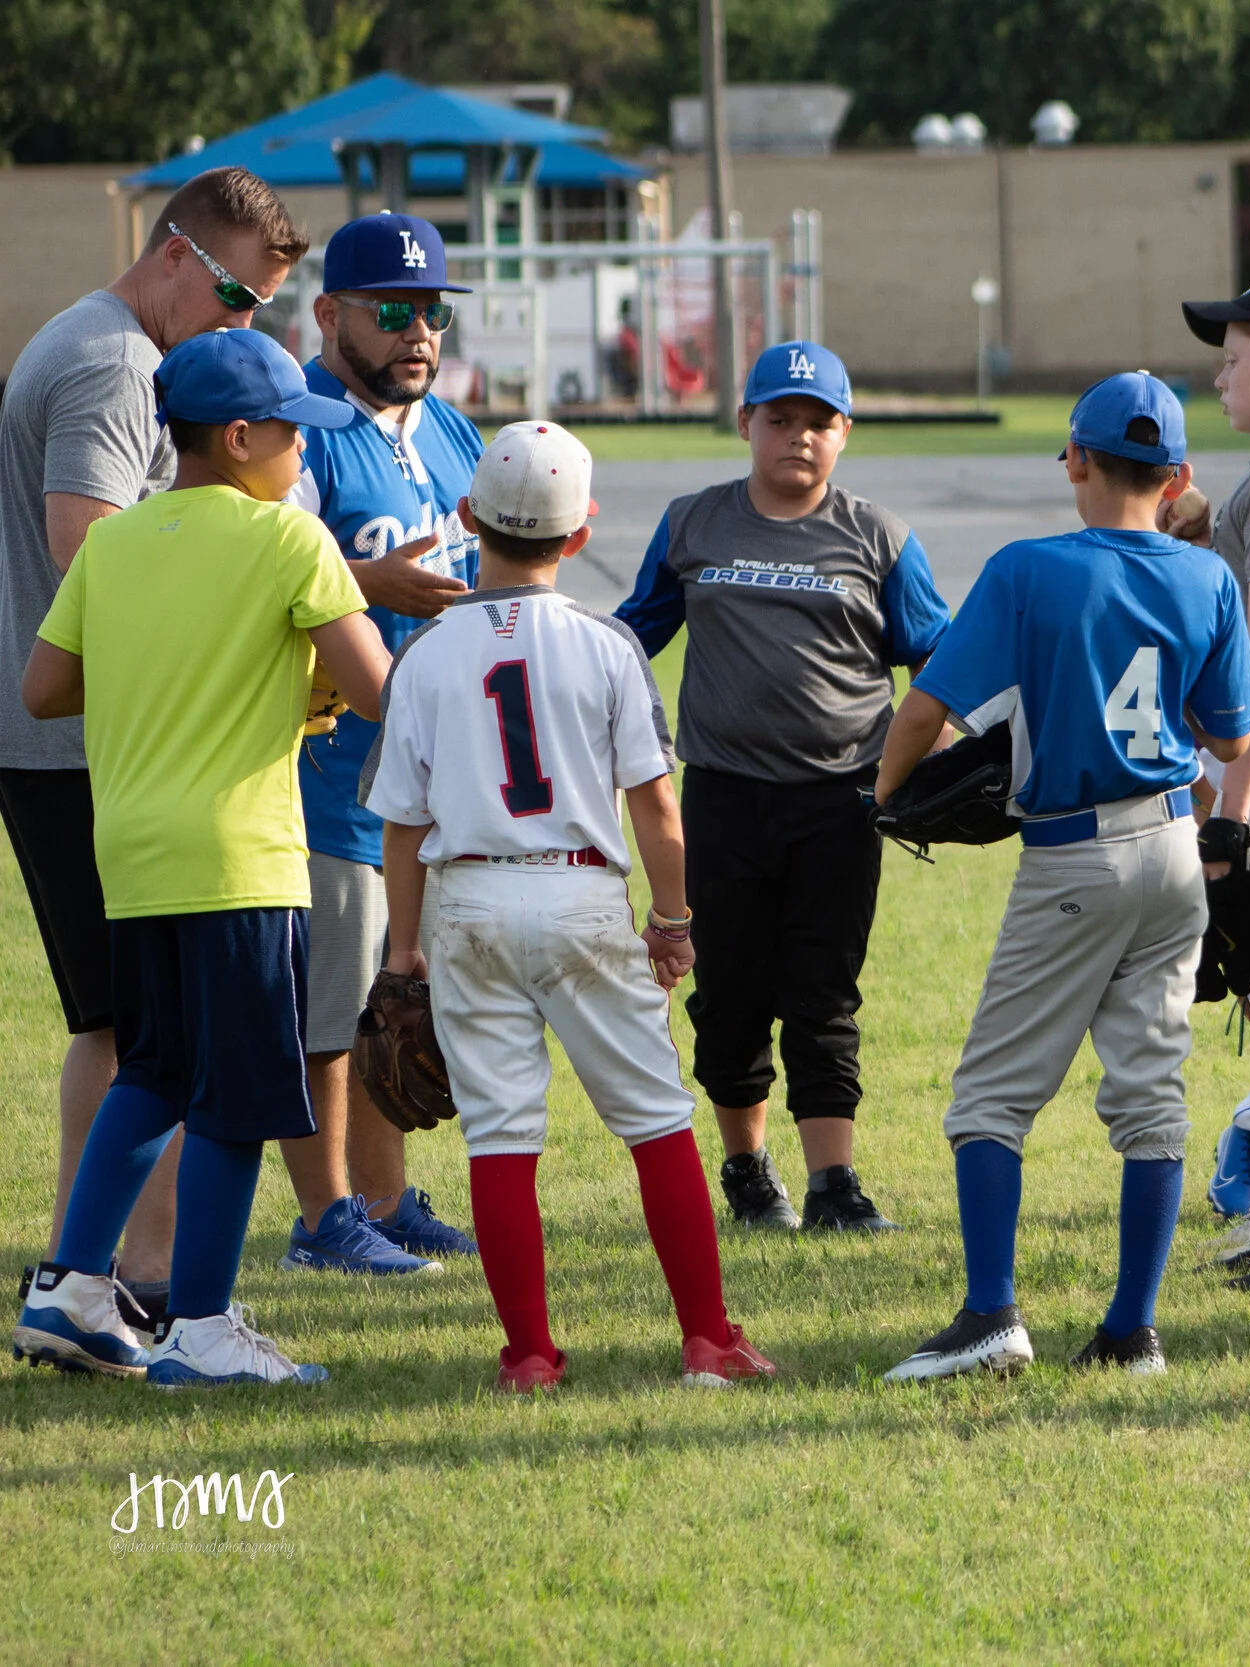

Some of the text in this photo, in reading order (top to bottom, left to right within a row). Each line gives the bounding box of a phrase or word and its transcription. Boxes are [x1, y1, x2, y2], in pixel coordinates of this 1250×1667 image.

[399, 231, 427, 268] LA
[788, 349, 816, 380] LA
[698, 567, 849, 596] BASEBALL
[732, 559, 816, 574] RAWLINGS
[1105, 646, 1161, 760] 4
[483, 659, 554, 819] 1
